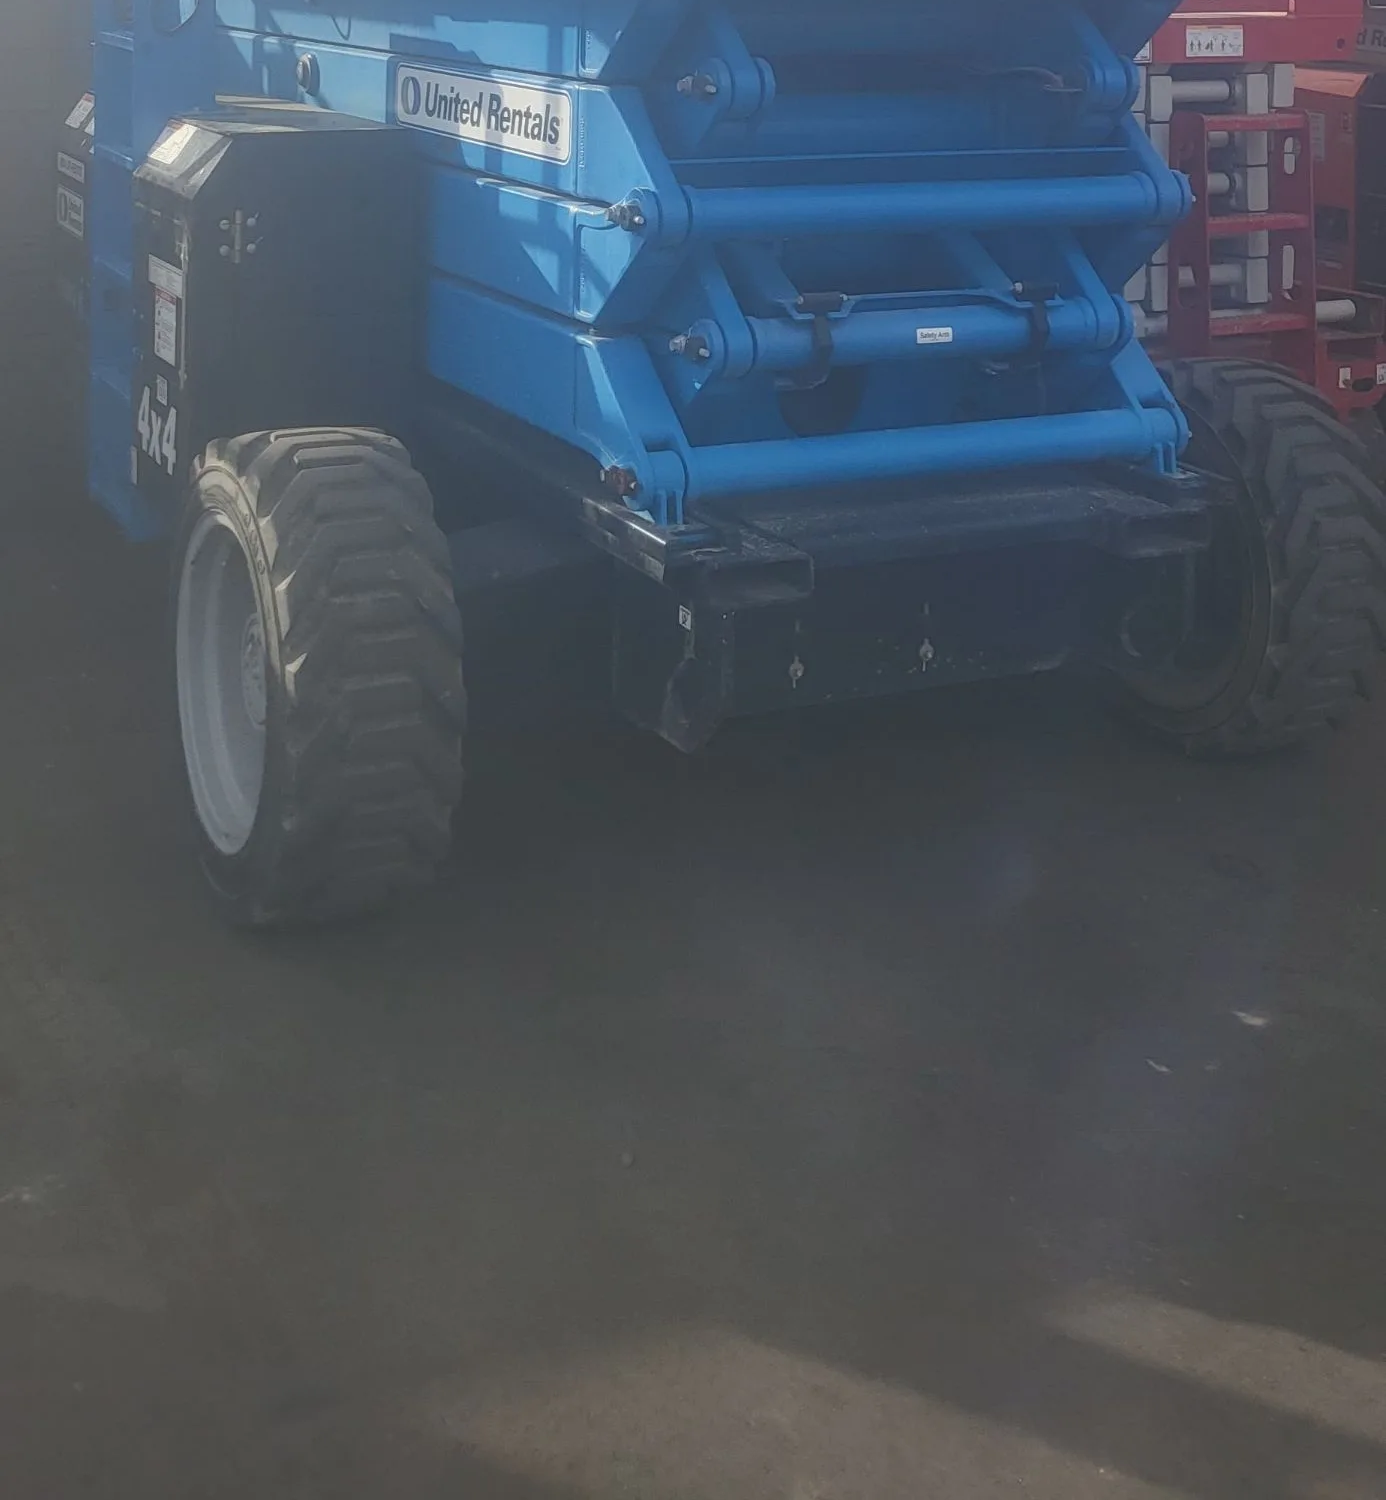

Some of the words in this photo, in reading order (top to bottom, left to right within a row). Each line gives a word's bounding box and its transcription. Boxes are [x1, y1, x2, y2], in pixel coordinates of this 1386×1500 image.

[424, 82, 484, 127] United
[486, 93, 561, 145] Rentals
[138, 385, 177, 476] 4x4
